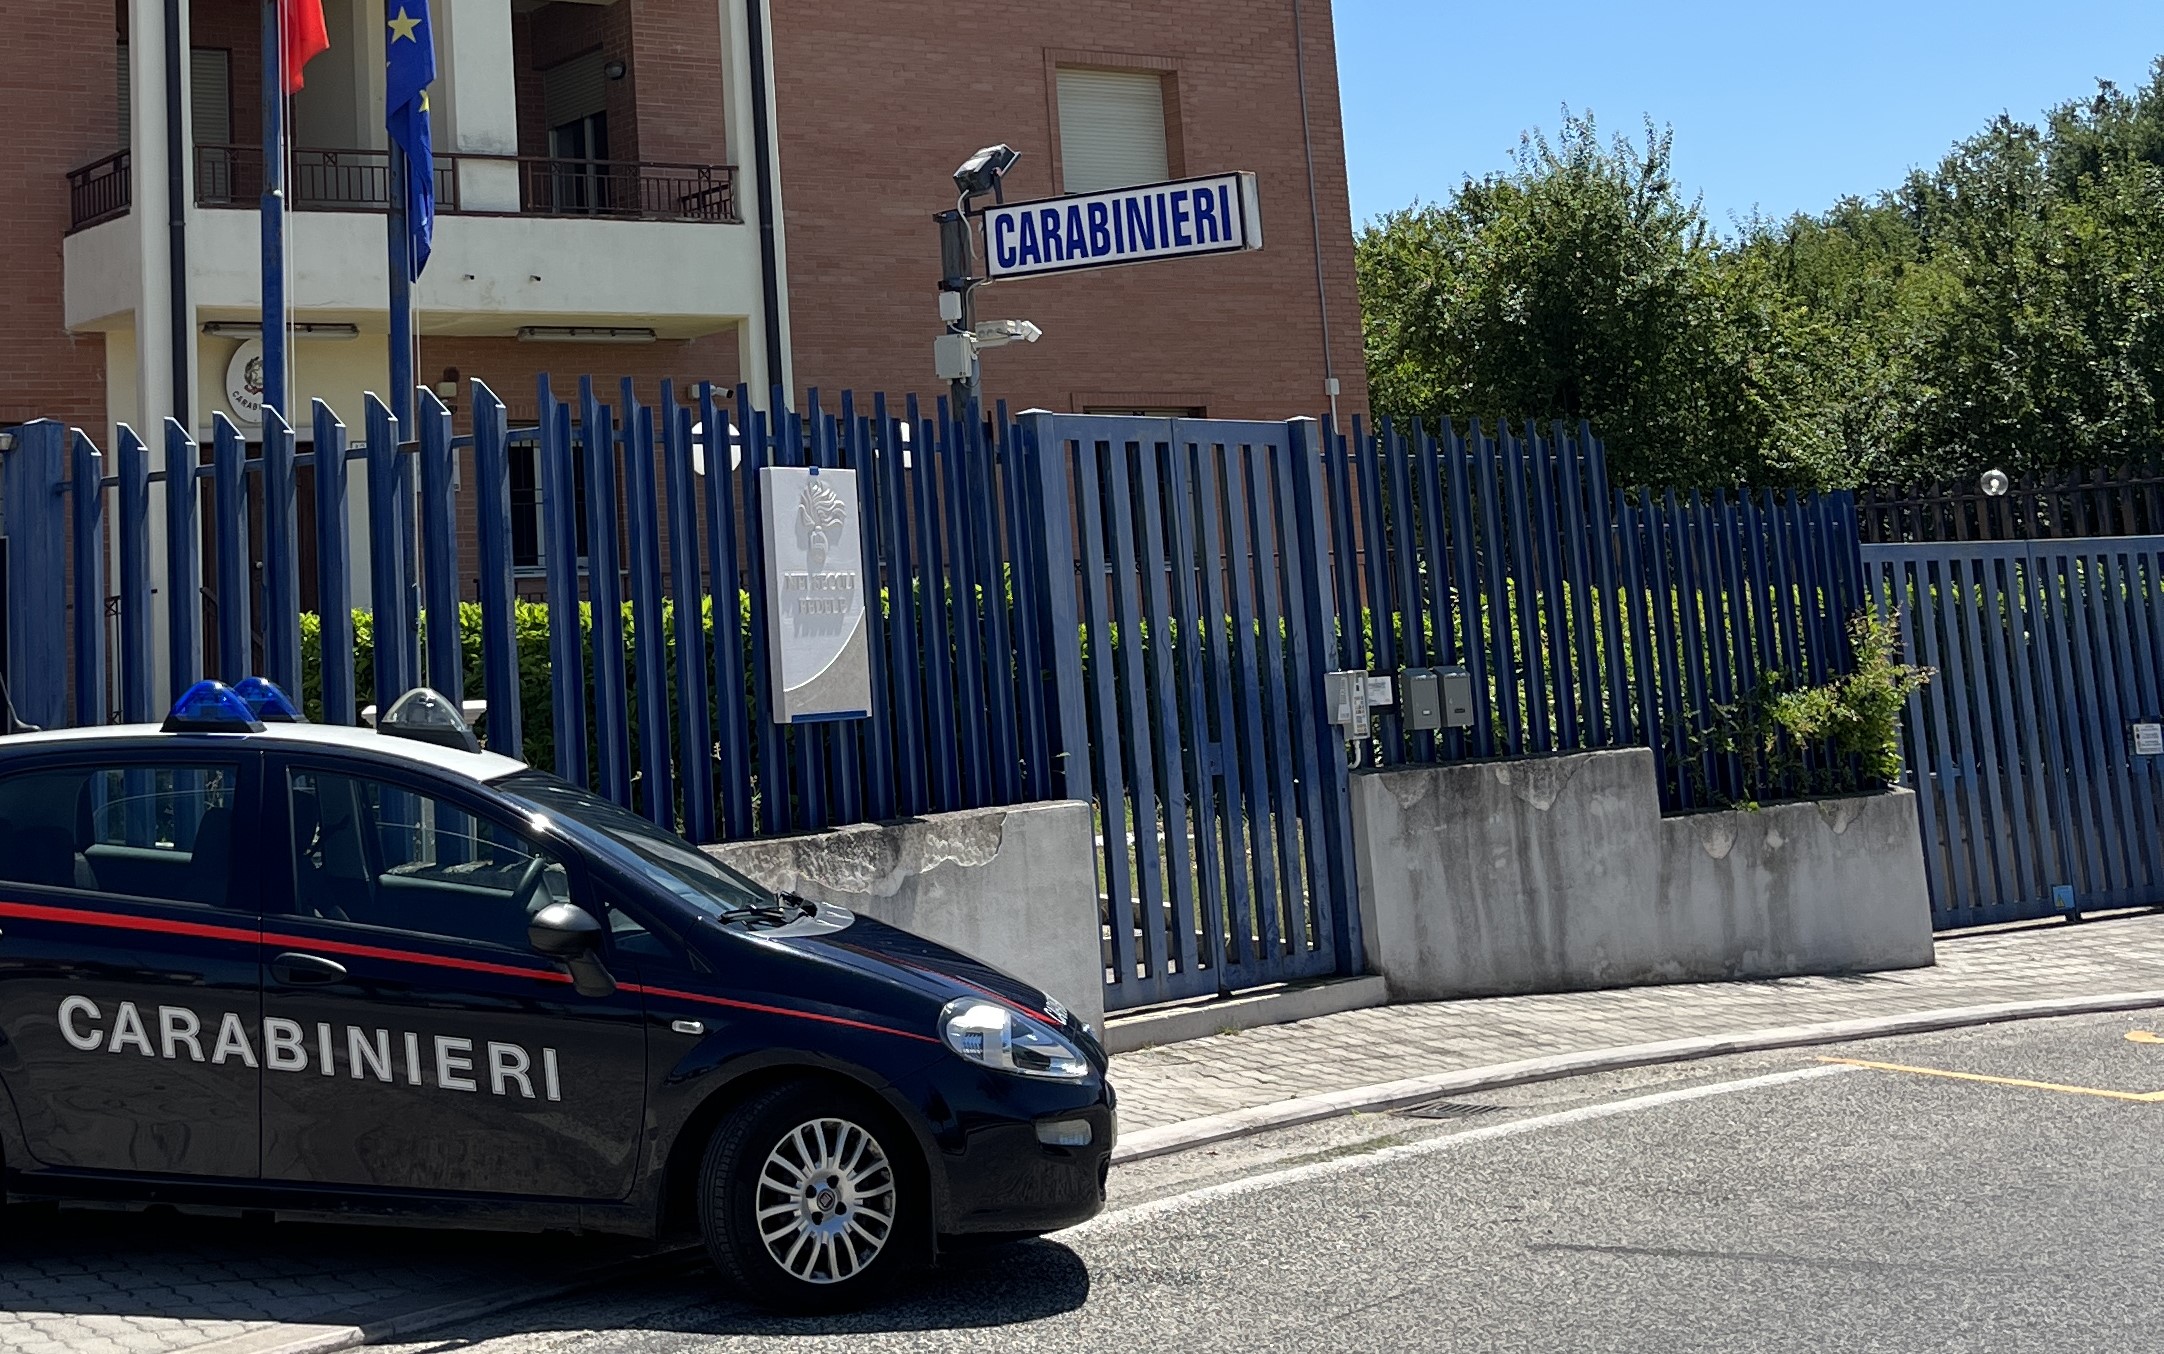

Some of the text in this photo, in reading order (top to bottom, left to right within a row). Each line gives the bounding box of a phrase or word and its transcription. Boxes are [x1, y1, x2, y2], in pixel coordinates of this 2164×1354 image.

[994, 184, 1233, 269] CARABINIERI
[232, 390, 262, 411] CARABI
[58, 995, 562, 1101] CARABINIERI
